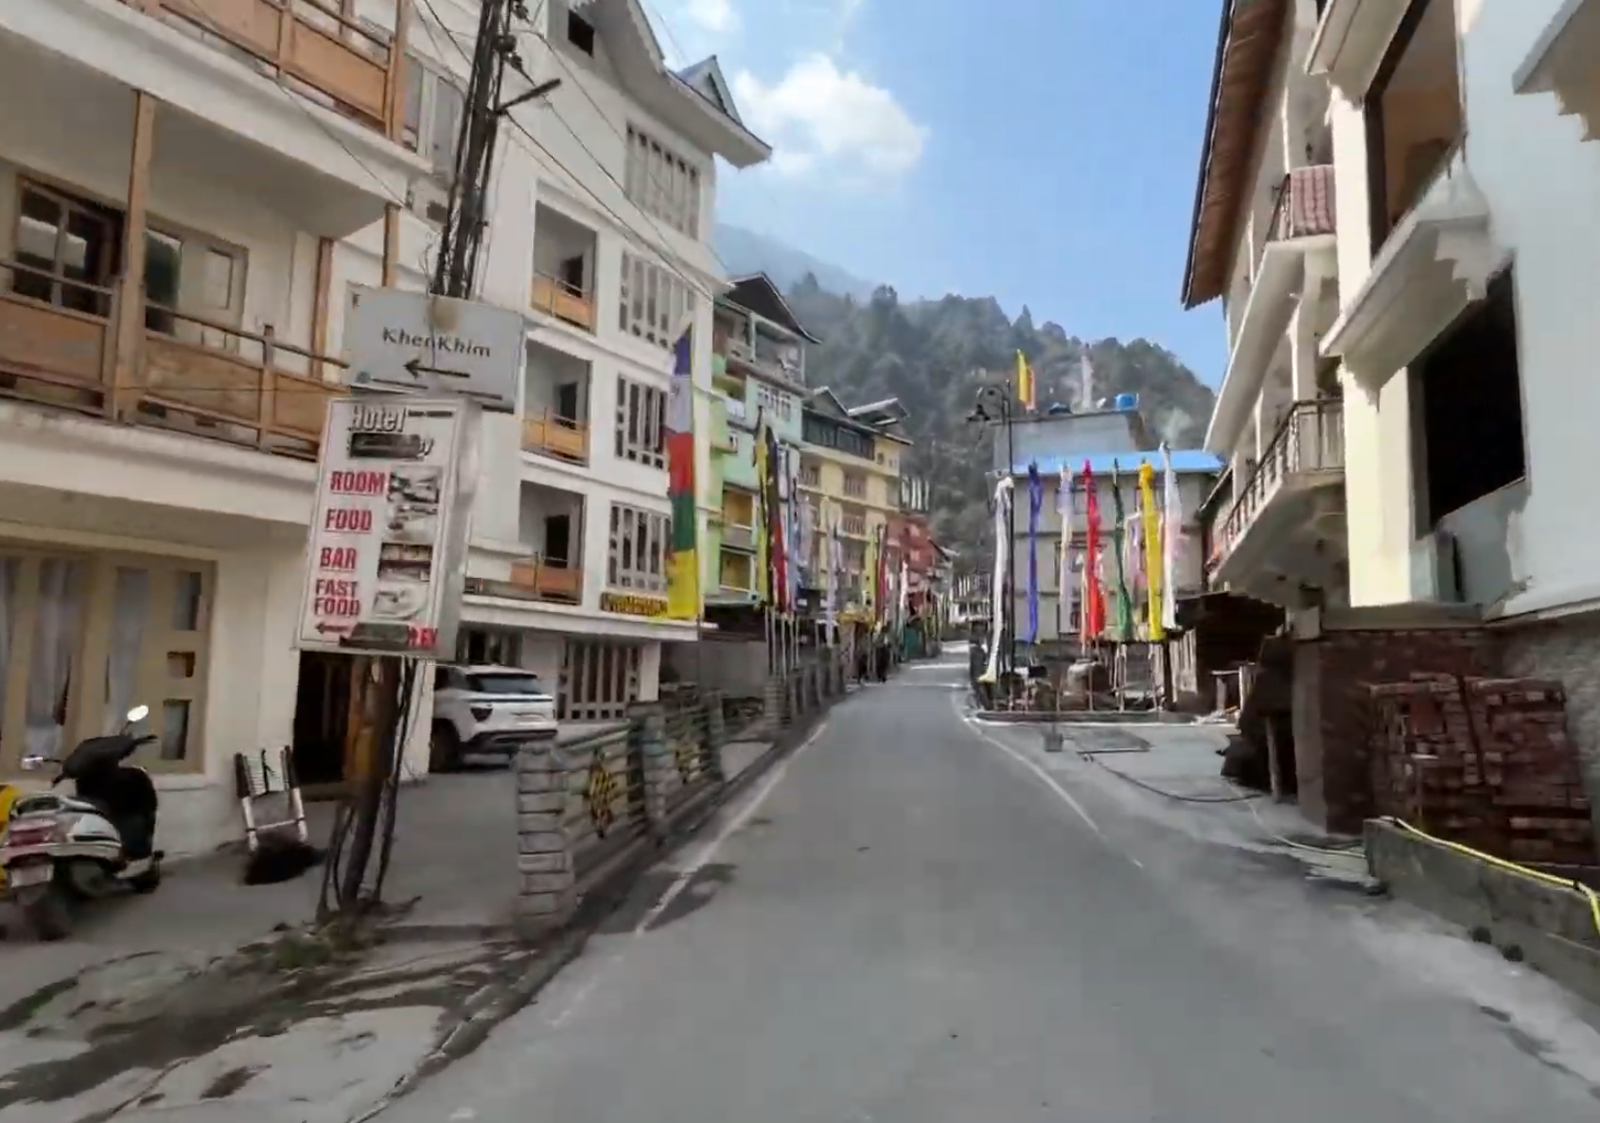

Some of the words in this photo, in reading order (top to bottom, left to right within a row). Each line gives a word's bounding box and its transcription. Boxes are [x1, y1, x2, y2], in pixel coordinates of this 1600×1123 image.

[349, 404, 407, 432] Hotel
[330, 471, 385, 493] ROOM
[325, 508, 372, 531] FOOD
[320, 547, 356, 569] BAR
[315, 579, 358, 598] FAST
[314, 597, 360, 616] FOOD
